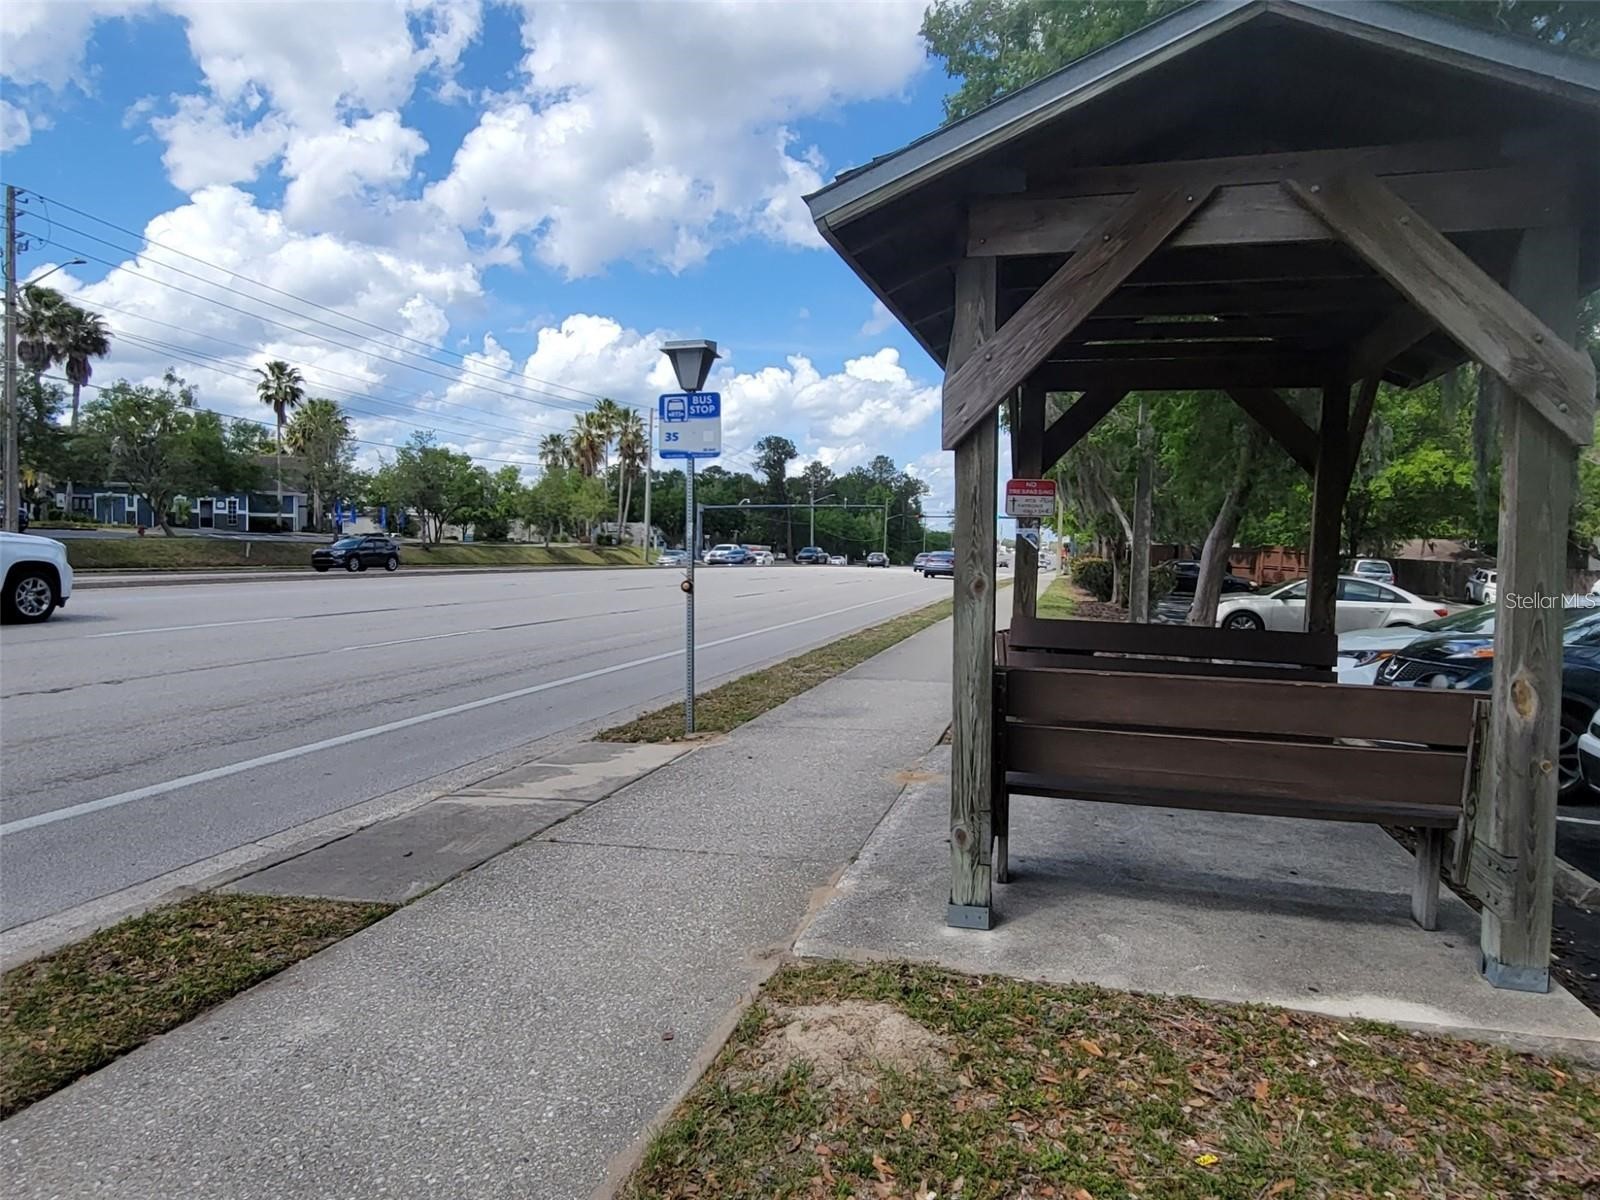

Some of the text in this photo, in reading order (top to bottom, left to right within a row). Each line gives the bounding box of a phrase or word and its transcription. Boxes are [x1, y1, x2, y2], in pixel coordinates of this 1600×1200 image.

[692, 396, 712, 404] BUS
[690, 405, 716, 414] STOP
[664, 432, 679, 442] 35
